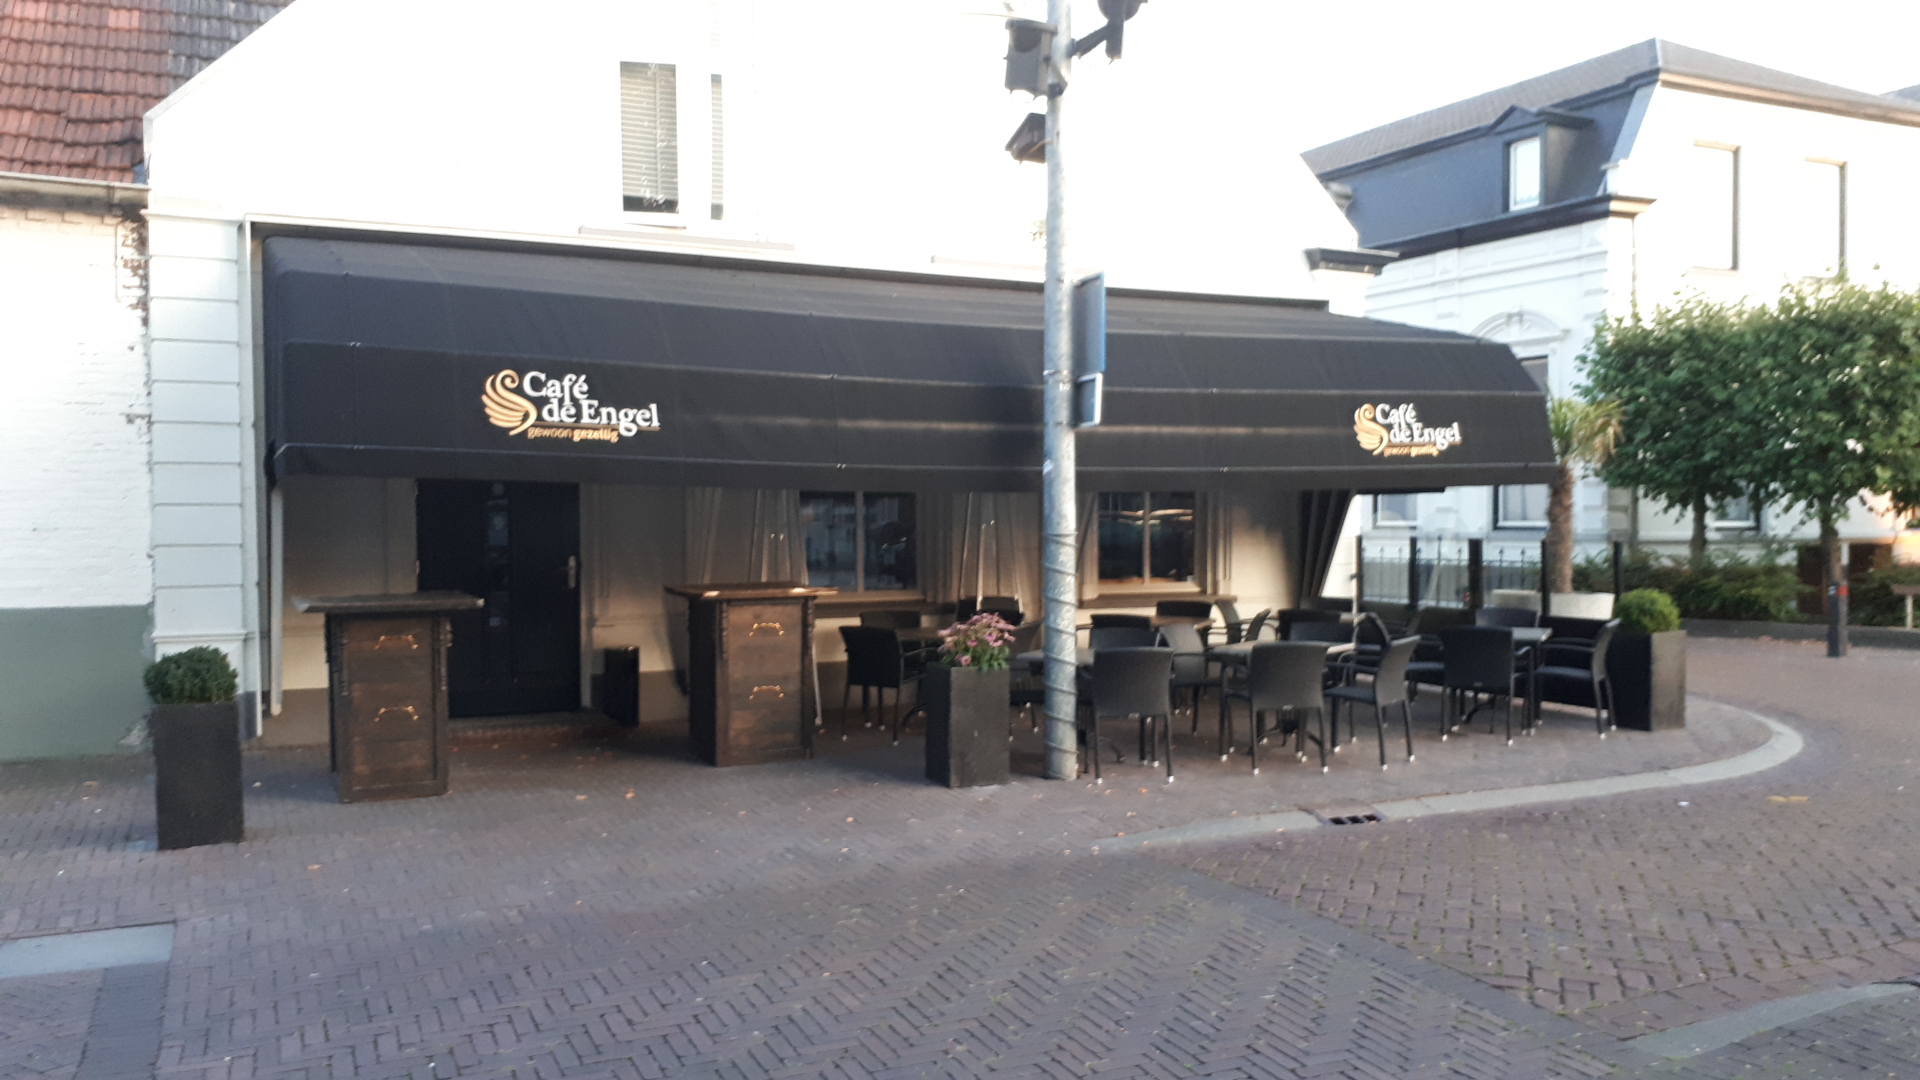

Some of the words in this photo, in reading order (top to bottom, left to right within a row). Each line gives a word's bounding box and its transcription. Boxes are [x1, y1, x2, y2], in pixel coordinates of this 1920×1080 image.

[523, 371, 590, 404] Café
[542, 398, 577, 423] de
[579, 399, 661, 437] Engel
[1375, 403, 1417, 428] Café
[527, 426, 573, 439] gewoon
[1389, 422, 1412, 443] de
[1412, 422, 1462, 451] Engel
